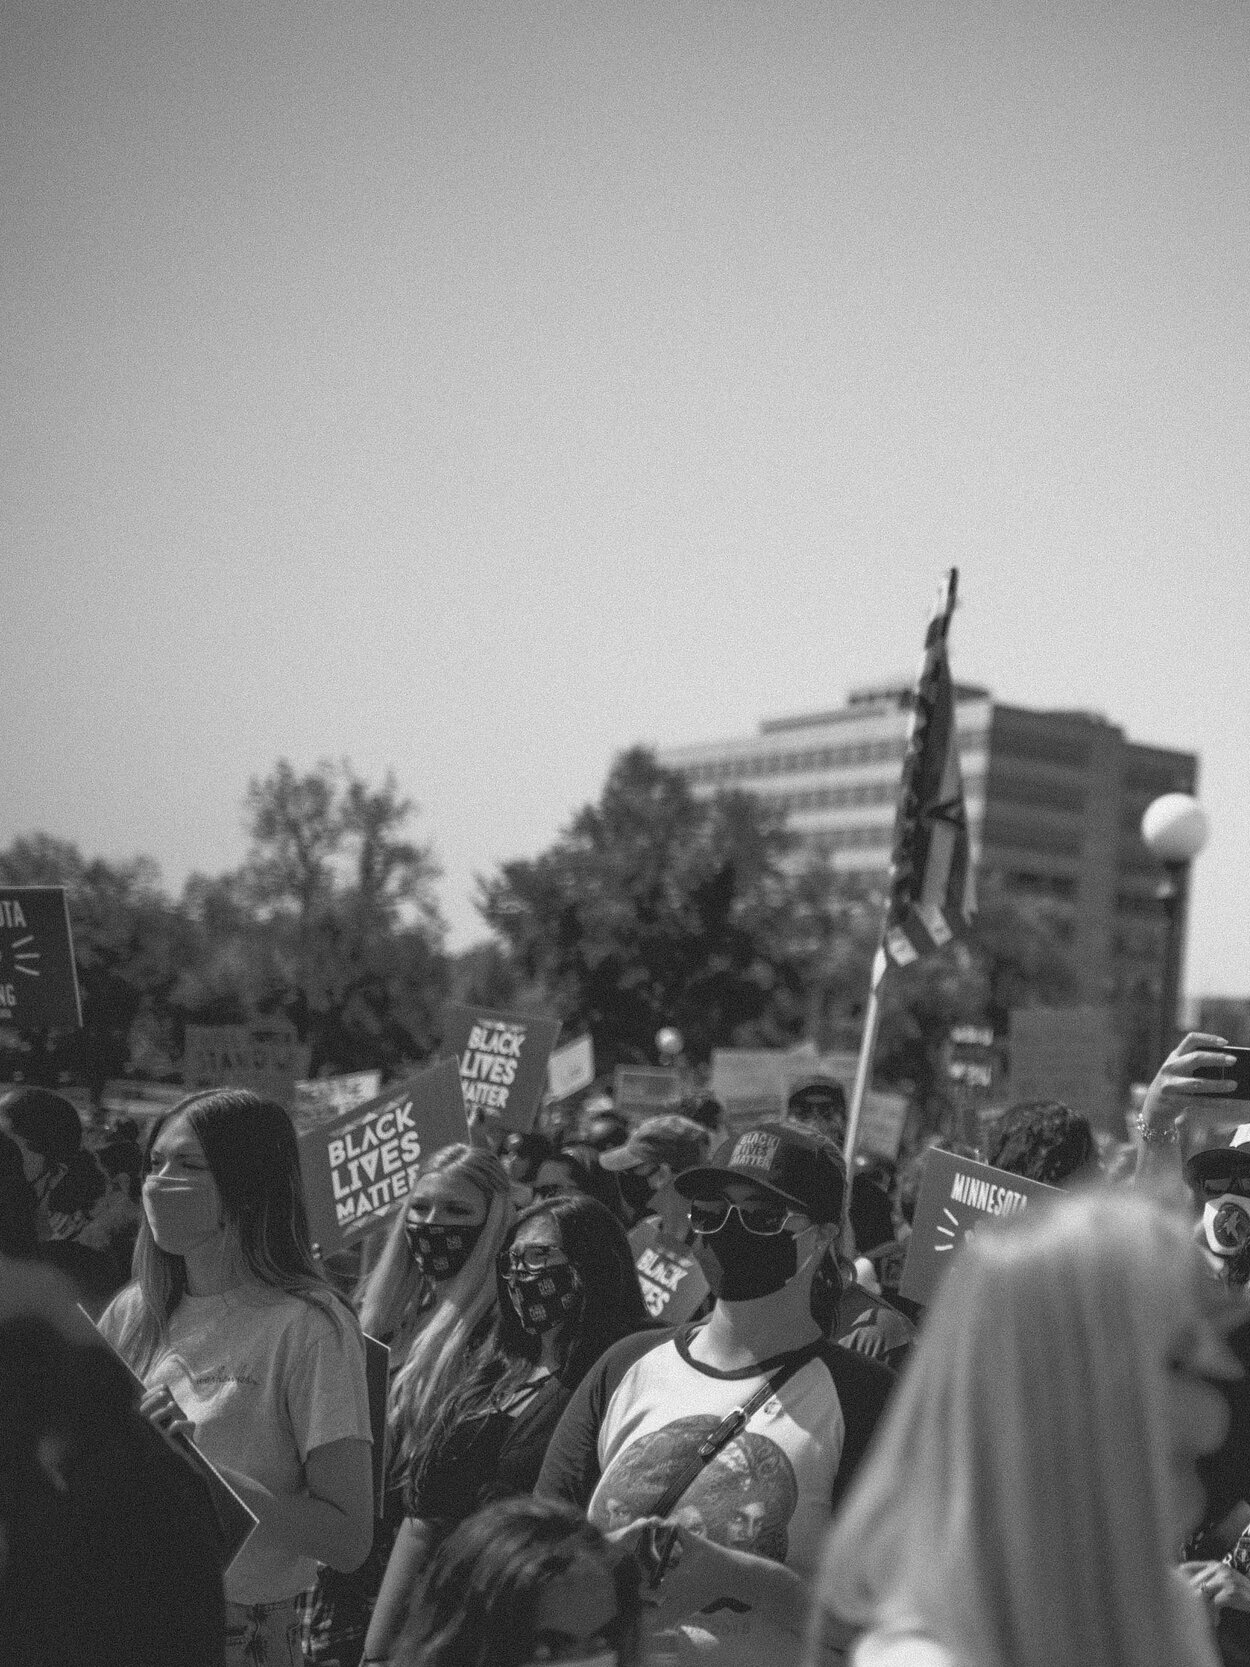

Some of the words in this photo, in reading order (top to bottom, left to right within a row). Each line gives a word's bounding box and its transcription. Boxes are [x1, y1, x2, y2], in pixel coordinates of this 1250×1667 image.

[468, 1026, 526, 1058] BLACK
[459, 1050, 518, 1086] LIVES
[328, 1101, 416, 1168] BLACK
[331, 1131, 421, 1200] LIVES
[637, 1249, 688, 1291] BLACK
